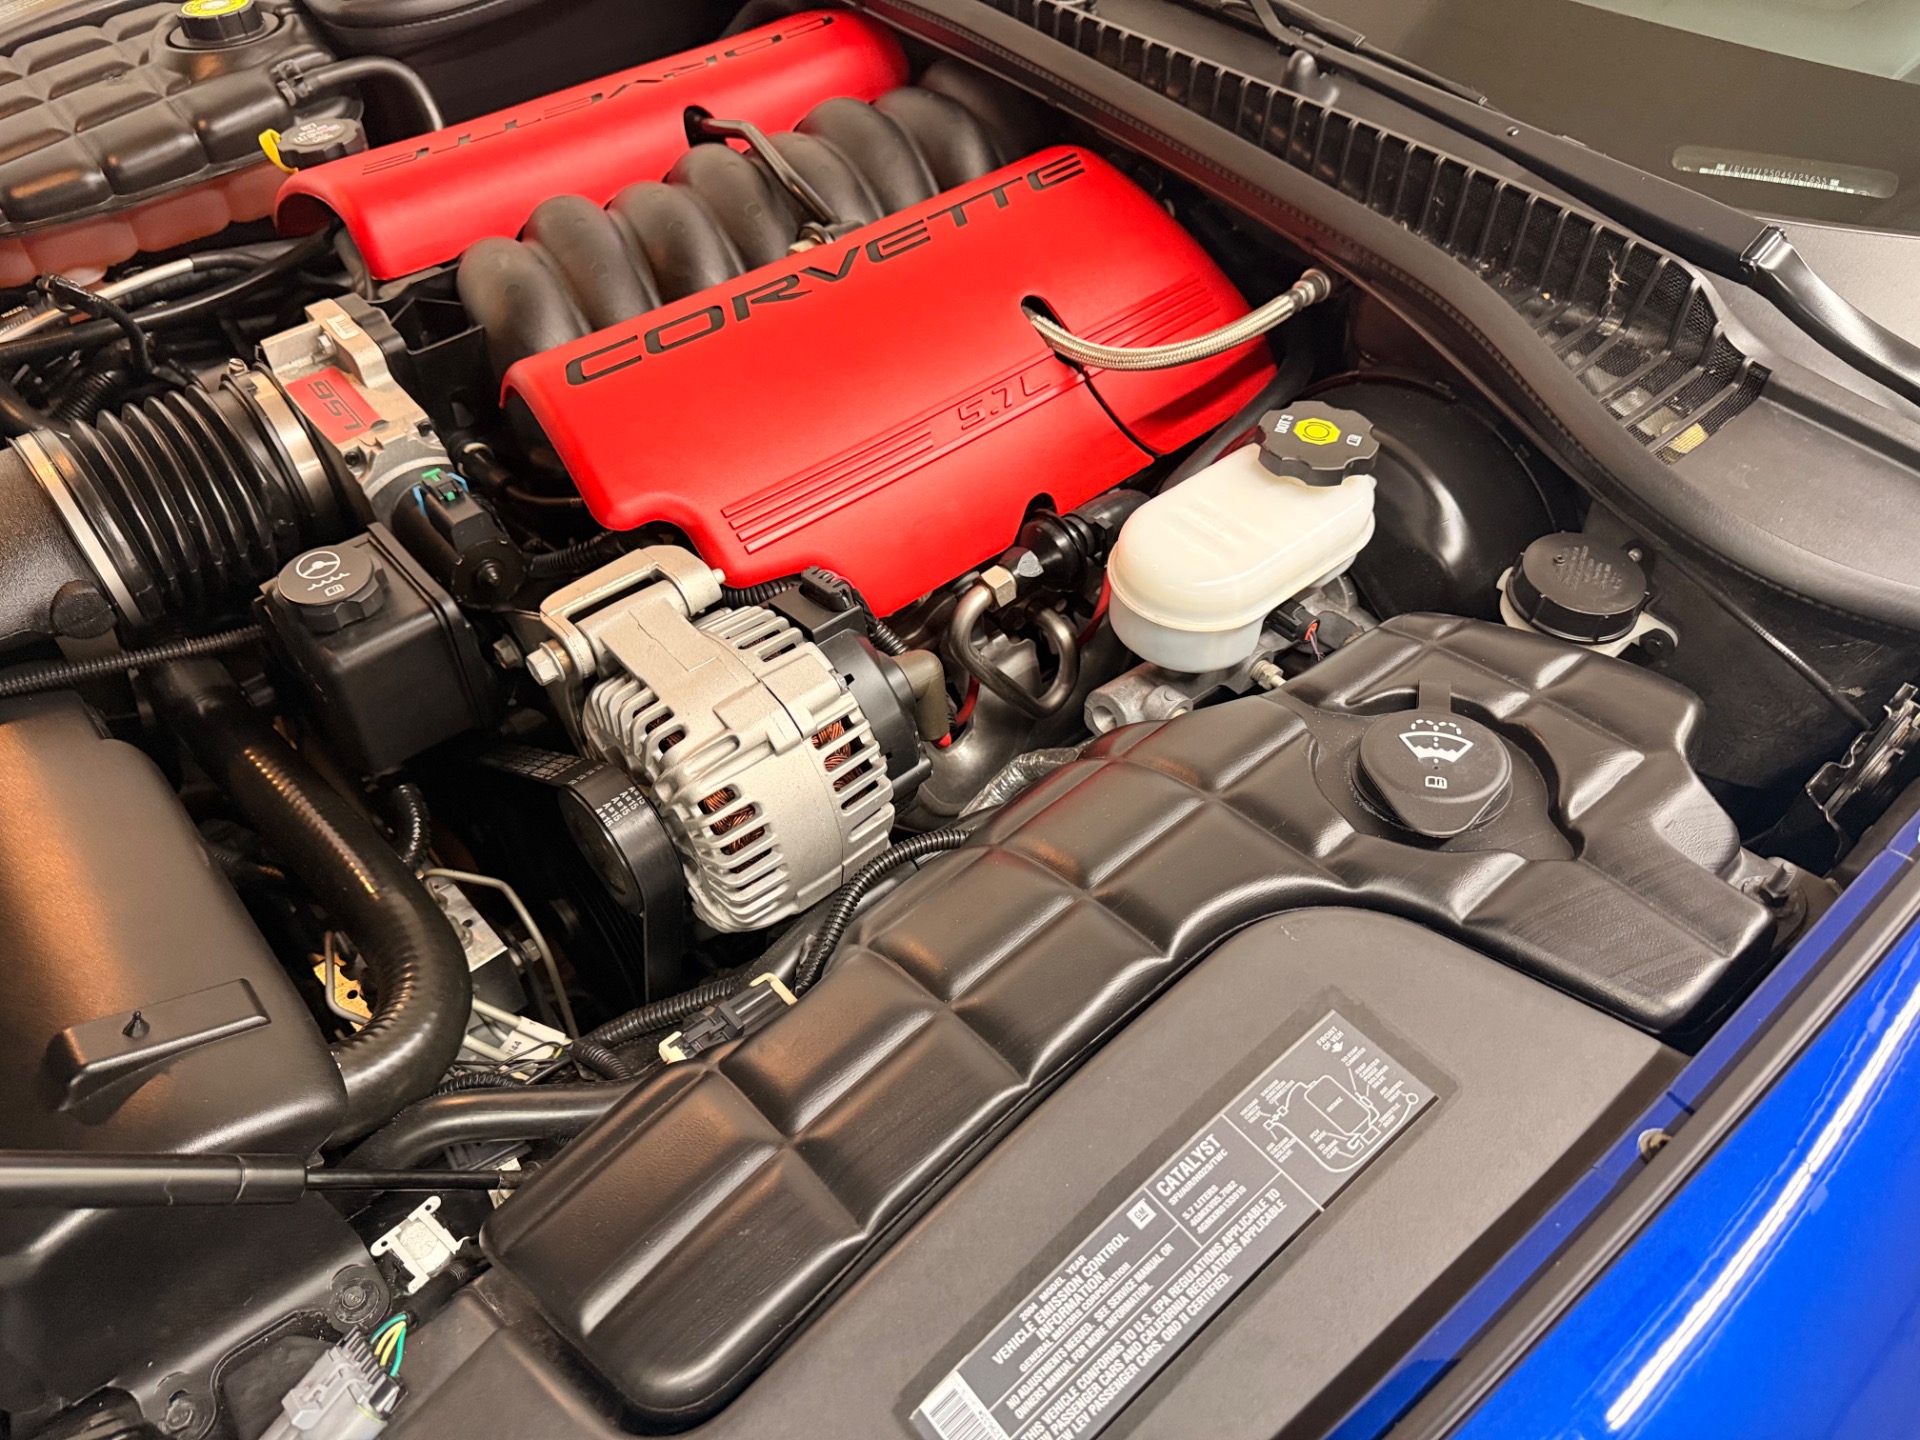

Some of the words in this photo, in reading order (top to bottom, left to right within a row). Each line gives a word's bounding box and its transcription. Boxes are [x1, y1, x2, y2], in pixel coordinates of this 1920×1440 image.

[565, 152, 1086, 387] CORVETTE
[307, 380, 363, 431] LS6
[1316, 1026, 1337, 1046] FRONT
[1322, 1041, 1334, 1050] OF
[1330, 1031, 1343, 1045] VEH
[1157, 1134, 1220, 1196] CATALYST
[1182, 1207, 1194, 1219] 5.7
[1193, 1185, 1218, 1209] LITERS
[1134, 1207, 1146, 1219] GM
[992, 1321, 1036, 1364] VEHICLE
[1034, 1275, 1084, 1324] EMISSION
[1082, 1233, 1129, 1277] CONTROL
[1007, 1395, 1020, 1409] NO
[1018, 1348, 1067, 1399] ADJUSTMENTS
[1064, 1323, 1095, 1351] NEEDED.
[1094, 1305, 1110, 1322] SEE
[1107, 1279, 1137, 1308] SERVICE
[1133, 1254, 1164, 1282] MANUAL
[1160, 1243, 1174, 1256] OR
[1019, 1303, 1038, 1321] 2004
[1039, 1277, 1066, 1301] MODEL
[1065, 1255, 1087, 1274] YEAR
[1020, 1340, 1054, 1372] GENERAL
[1051, 1309, 1083, 1340] MOTORS
[1082, 1262, 1130, 1310] CORPORATION
[1036, 1271, 1105, 1340] INFORMATION
[1041, 1386, 1079, 1424] VEHICLE
[1077, 1342, 1124, 1389] CONFORMS
[1121, 1329, 1136, 1344] TO
[1133, 1314, 1155, 1332] U.S.
[1152, 1295, 1172, 1314] EPA
[1168, 1243, 1224, 1298] REGULATIONS
[1222, 1199, 1269, 1246] APPLICABLE
[1265, 1189, 1280, 1201] TO
[1050, 1383, 1102, 1435] PASSENGER
[1099, 1360, 1124, 1385] CARS
[1122, 1341, 1142, 1363] AND
[1140, 1296, 1190, 1344] CALIFORNIA
[1186, 1243, 1242, 1298] REGULATIONS
[1240, 1199, 1287, 1247] APPLICABLE
[1015, 1386, 1047, 1419] OWNERS
[1043, 1360, 1075, 1390] MANUAL
[1071, 1345, 1089, 1362] FOR
[1085, 1325, 1108, 1348] MORE
[1105, 1283, 1153, 1329] INFORMATION.
[1071, 1412, 1090, 1432] LEV
[1088, 1364, 1140, 1415] PASSENGER
[1136, 1340, 1165, 1366] CARS.
[1161, 1320, 1182, 1341] OBD
[1187, 1273, 1232, 1316] CERTIFIED.
